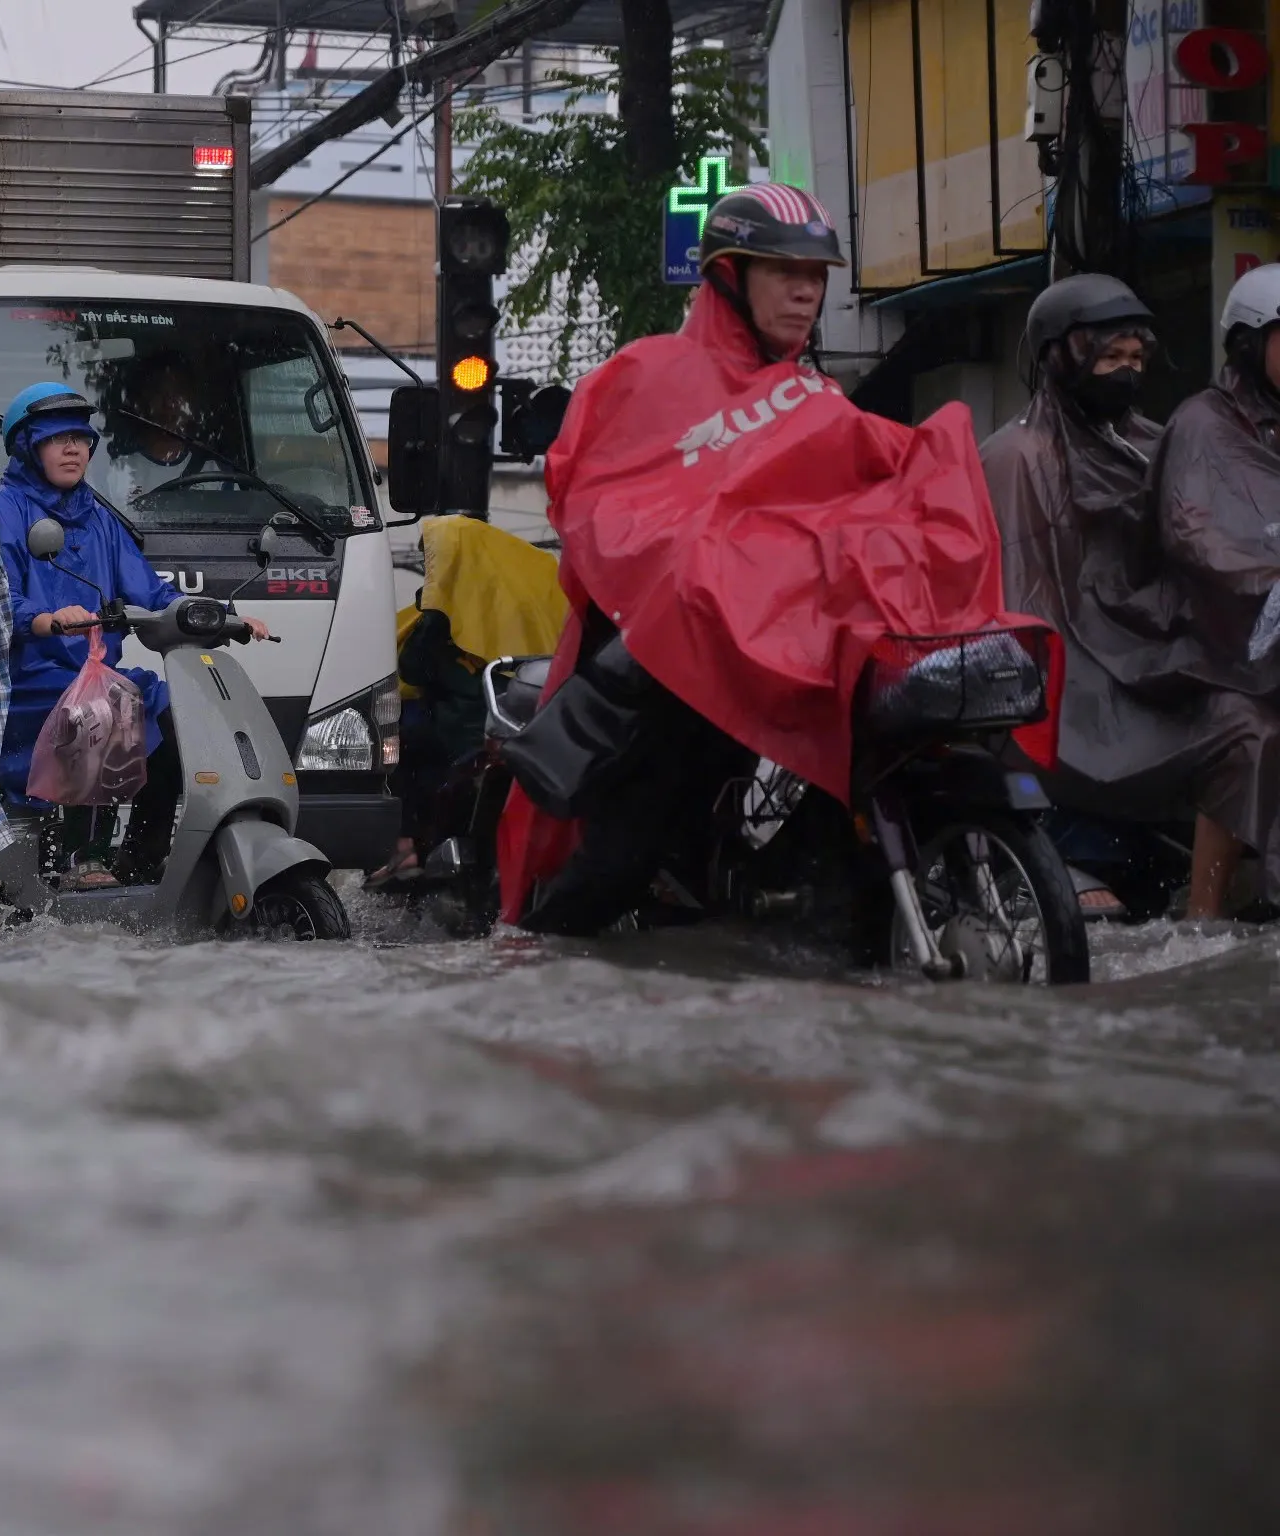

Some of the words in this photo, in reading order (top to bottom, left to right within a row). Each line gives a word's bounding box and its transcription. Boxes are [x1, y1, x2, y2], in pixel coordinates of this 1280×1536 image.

[81, 311, 104, 322] TÂY
[105, 310, 128, 323] BẮC
[130, 312, 149, 324] SÀI
[151, 314, 174, 325] GÒN
[267, 568, 327, 580] QKR
[267, 581, 328, 593] 270
